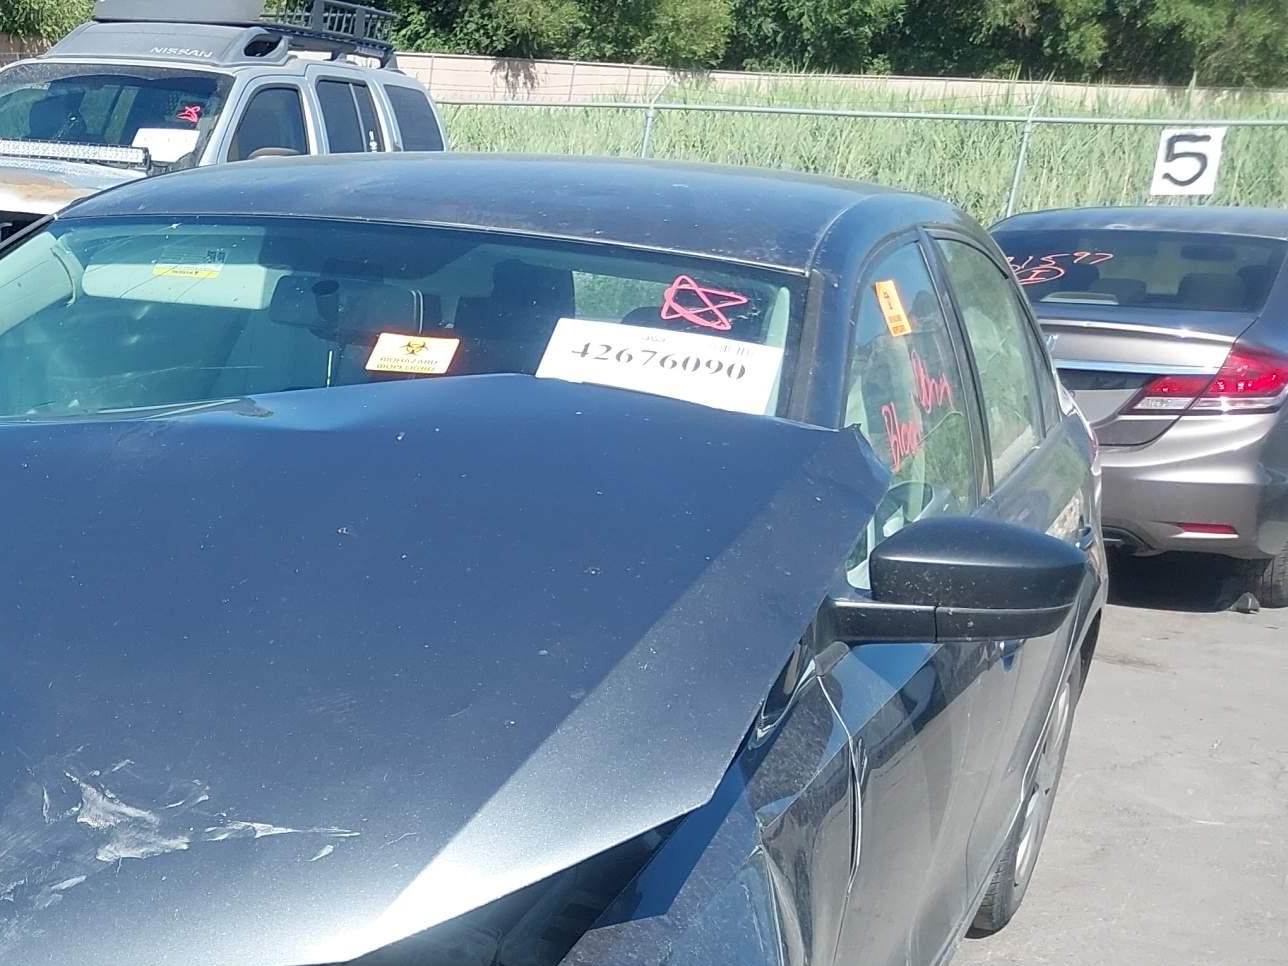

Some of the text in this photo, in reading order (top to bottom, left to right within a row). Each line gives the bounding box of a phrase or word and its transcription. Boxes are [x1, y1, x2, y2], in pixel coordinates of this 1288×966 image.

[150, 47, 213, 58] NISSAN
[1162, 134, 1212, 187] 5
[571, 342, 746, 380] 42676090
